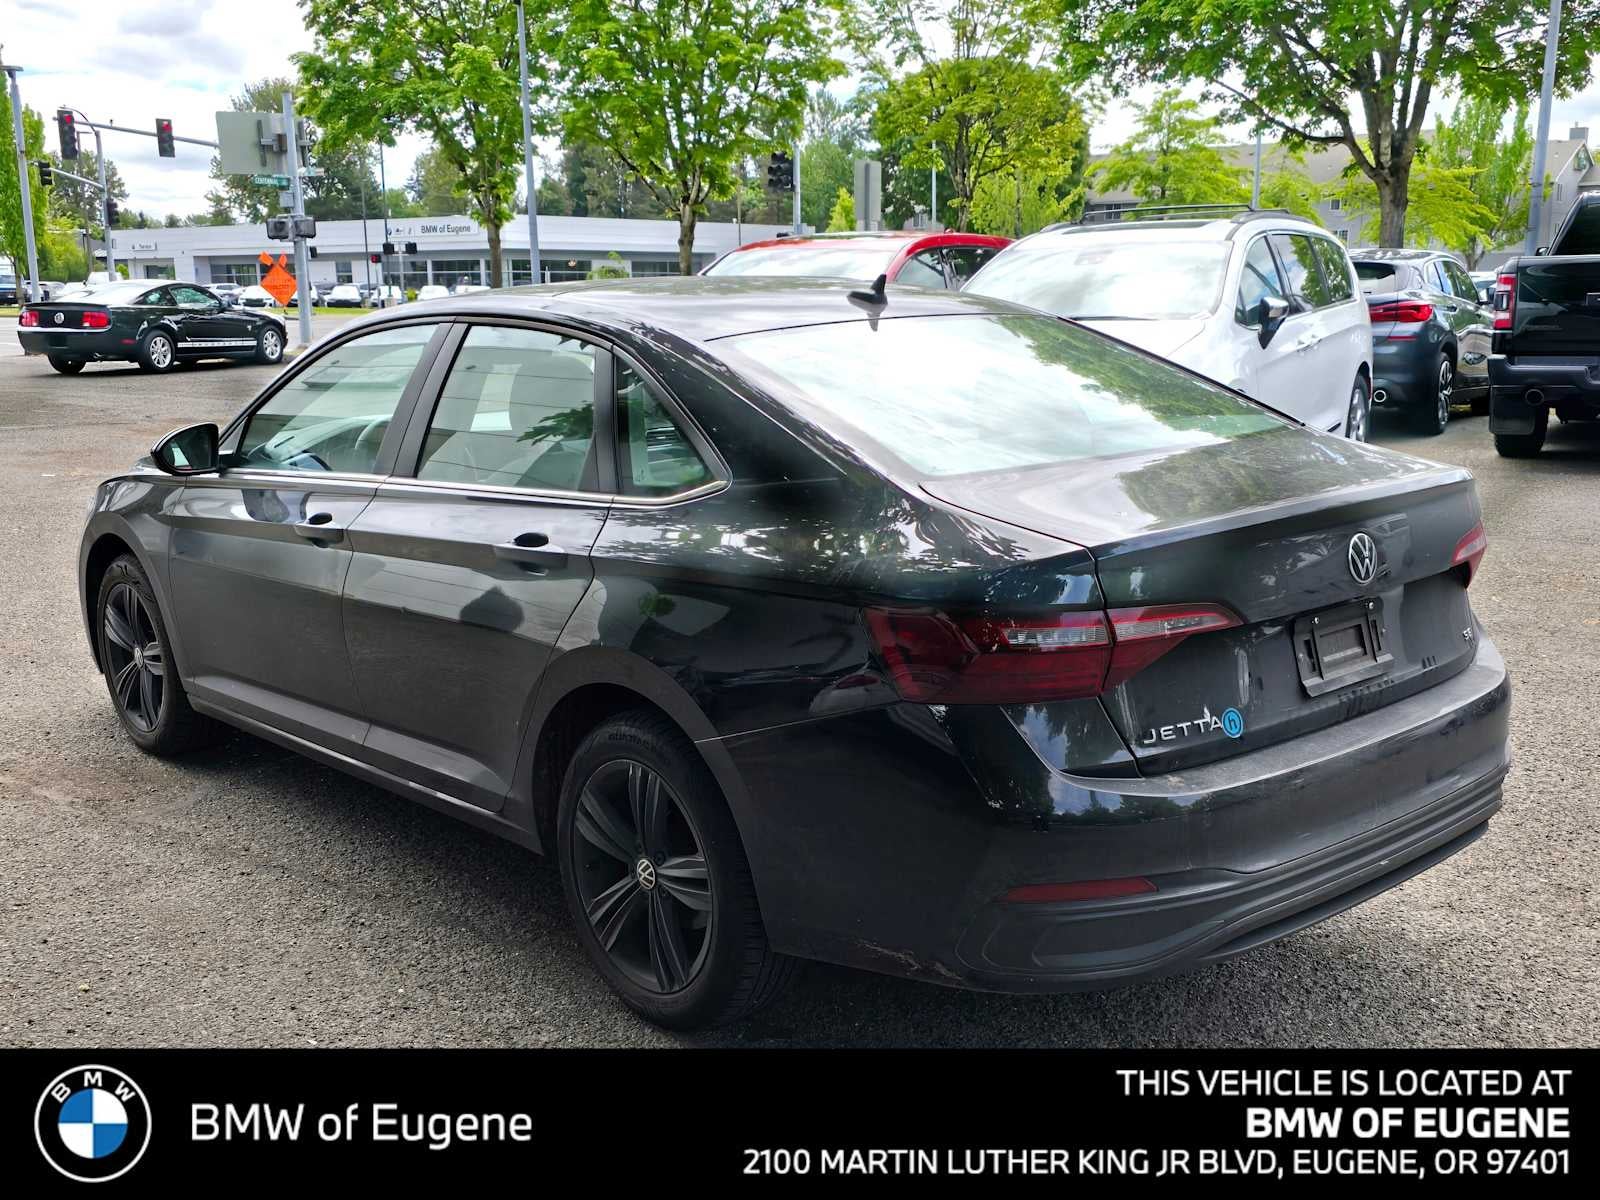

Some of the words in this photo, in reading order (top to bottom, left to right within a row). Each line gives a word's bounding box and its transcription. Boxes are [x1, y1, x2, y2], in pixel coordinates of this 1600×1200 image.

[421, 225, 437, 234] BMW
[439, 225, 445, 233] of
[447, 224, 471, 235] Eugene
[1143, 716, 1222, 744] JETTA
